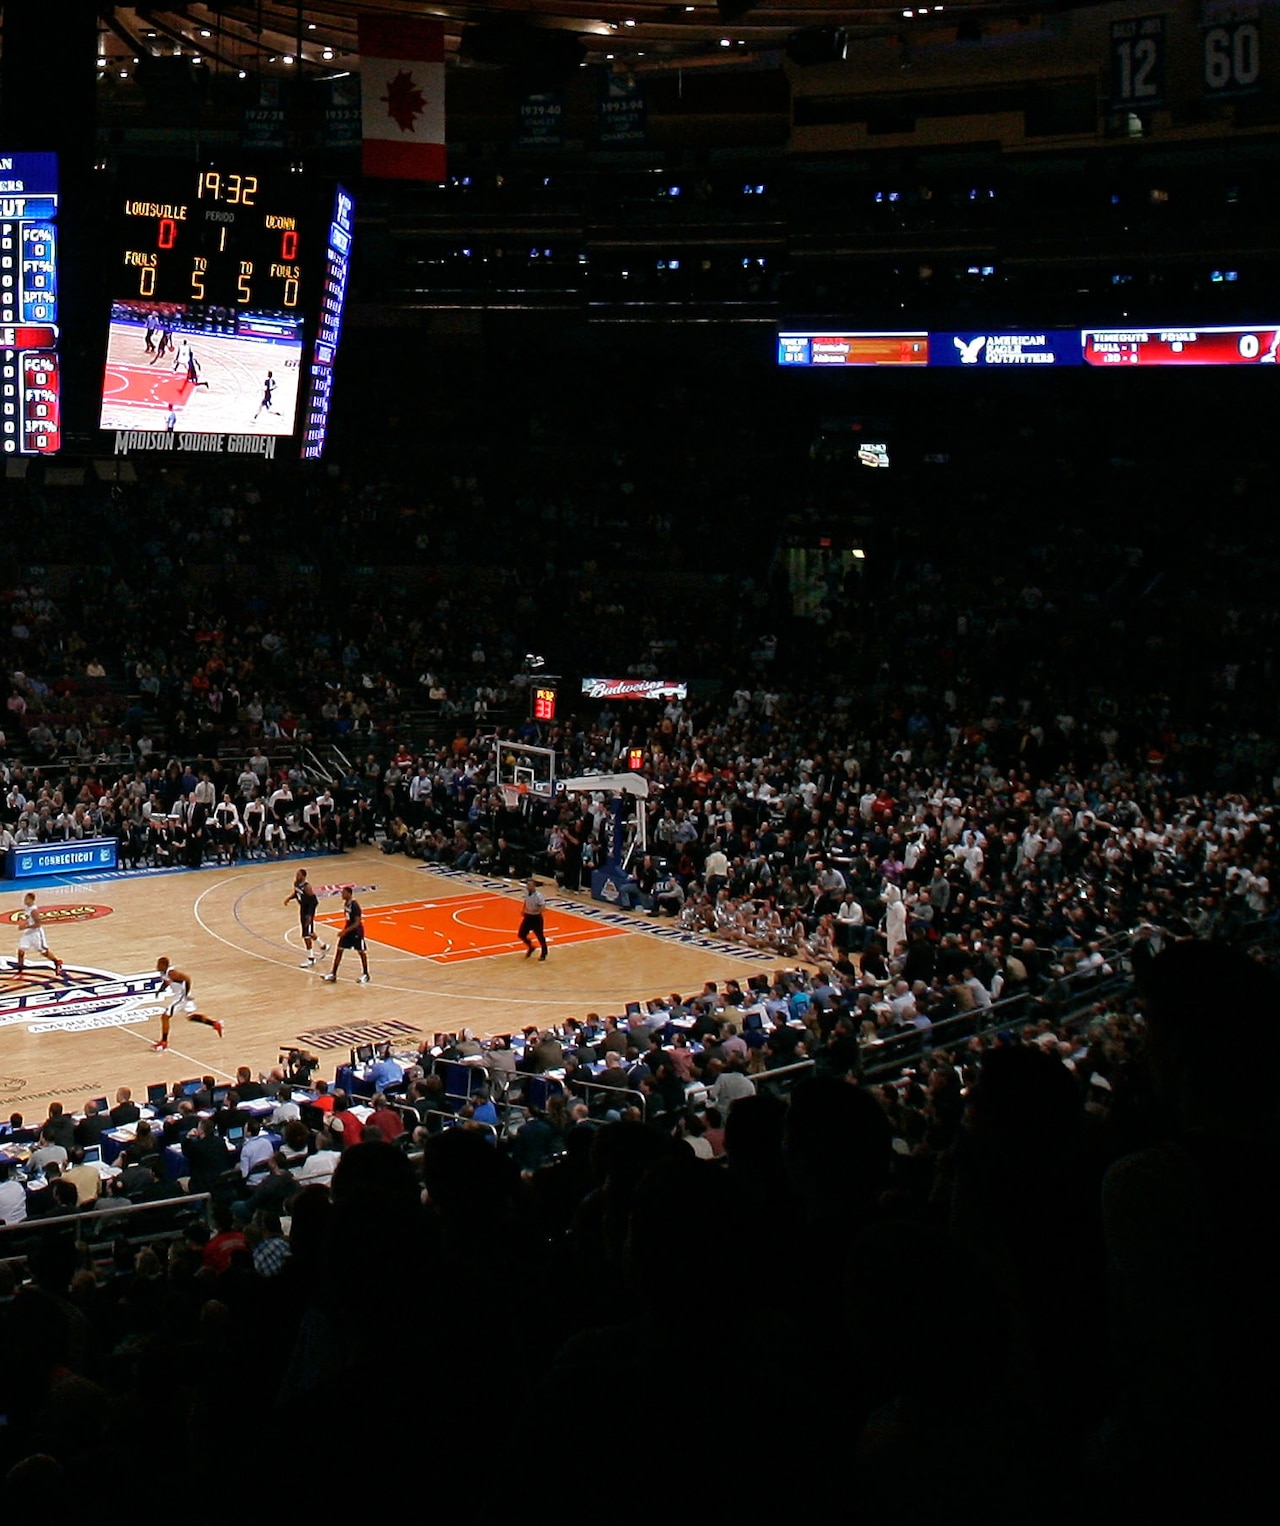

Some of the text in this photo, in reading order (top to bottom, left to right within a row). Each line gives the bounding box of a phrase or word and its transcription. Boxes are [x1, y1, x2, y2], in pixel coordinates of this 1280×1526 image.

[1205, 24, 1260, 88] 60
[1117, 38, 1159, 98] 12
[197, 172, 258, 205] 19:32
[125, 200, 187, 220] LOUISVILLE
[265, 215, 296, 231] UCONN
[2, 224, 12, 236] P
[23, 229, 51, 242] FG%
[158, 219, 176, 249] 0
[2, 238, 12, 249] 0
[219, 227, 226, 252] 1
[282, 231, 298, 260] 0
[34, 244, 45, 256] 0
[2, 257, 12, 268] 0
[23, 260, 54, 274] FT%
[125, 250, 208, 271] FOULS TO
[239, 261, 300, 279] TO FOULS
[2, 275, 12, 287] 0
[35, 275, 45, 287] 0
[140, 267, 155, 296] 0
[191, 271, 204, 300] 5
[237, 275, 251, 303] 5
[284, 279, 298, 306] 0
[2, 292, 12, 304] 0
[24, 291, 55, 304] 3PT%
[2, 310, 12, 321] 0
[35, 305, 46, 318] 0
[986, 335, 1046, 346] AMERICAN
[1093, 333, 1197, 342] TIMEOUTS FOULS
[986, 345, 1022, 354] EAGLE
[1239, 334, 1259, 358] 0
[6, 350, 14, 361] P
[985, 353, 1055, 363] OUTFITTERS
[4, 365, 14, 376] 0
[25, 360, 54, 373] FG%
[36, 373, 46, 385] 0
[4, 384, 14, 395] 0
[26, 390, 56, 404] FT%
[4, 402, 14, 414] 0
[37, 404, 47, 417] 0
[4, 420, 14, 433] 0
[25, 421, 57, 434] 3PT%
[5, 439, 15, 451] 0
[37, 435, 47, 448] 0
[114, 431, 276, 459] MADISON SQUARE GARDEN
[586, 680, 664, 698] Budweiser
[38, 851, 94, 866] CONNECTICUT
[544, 897, 776, 961] CHAMPIONSHIP
[296, 1019, 423, 1050] GARDEN
